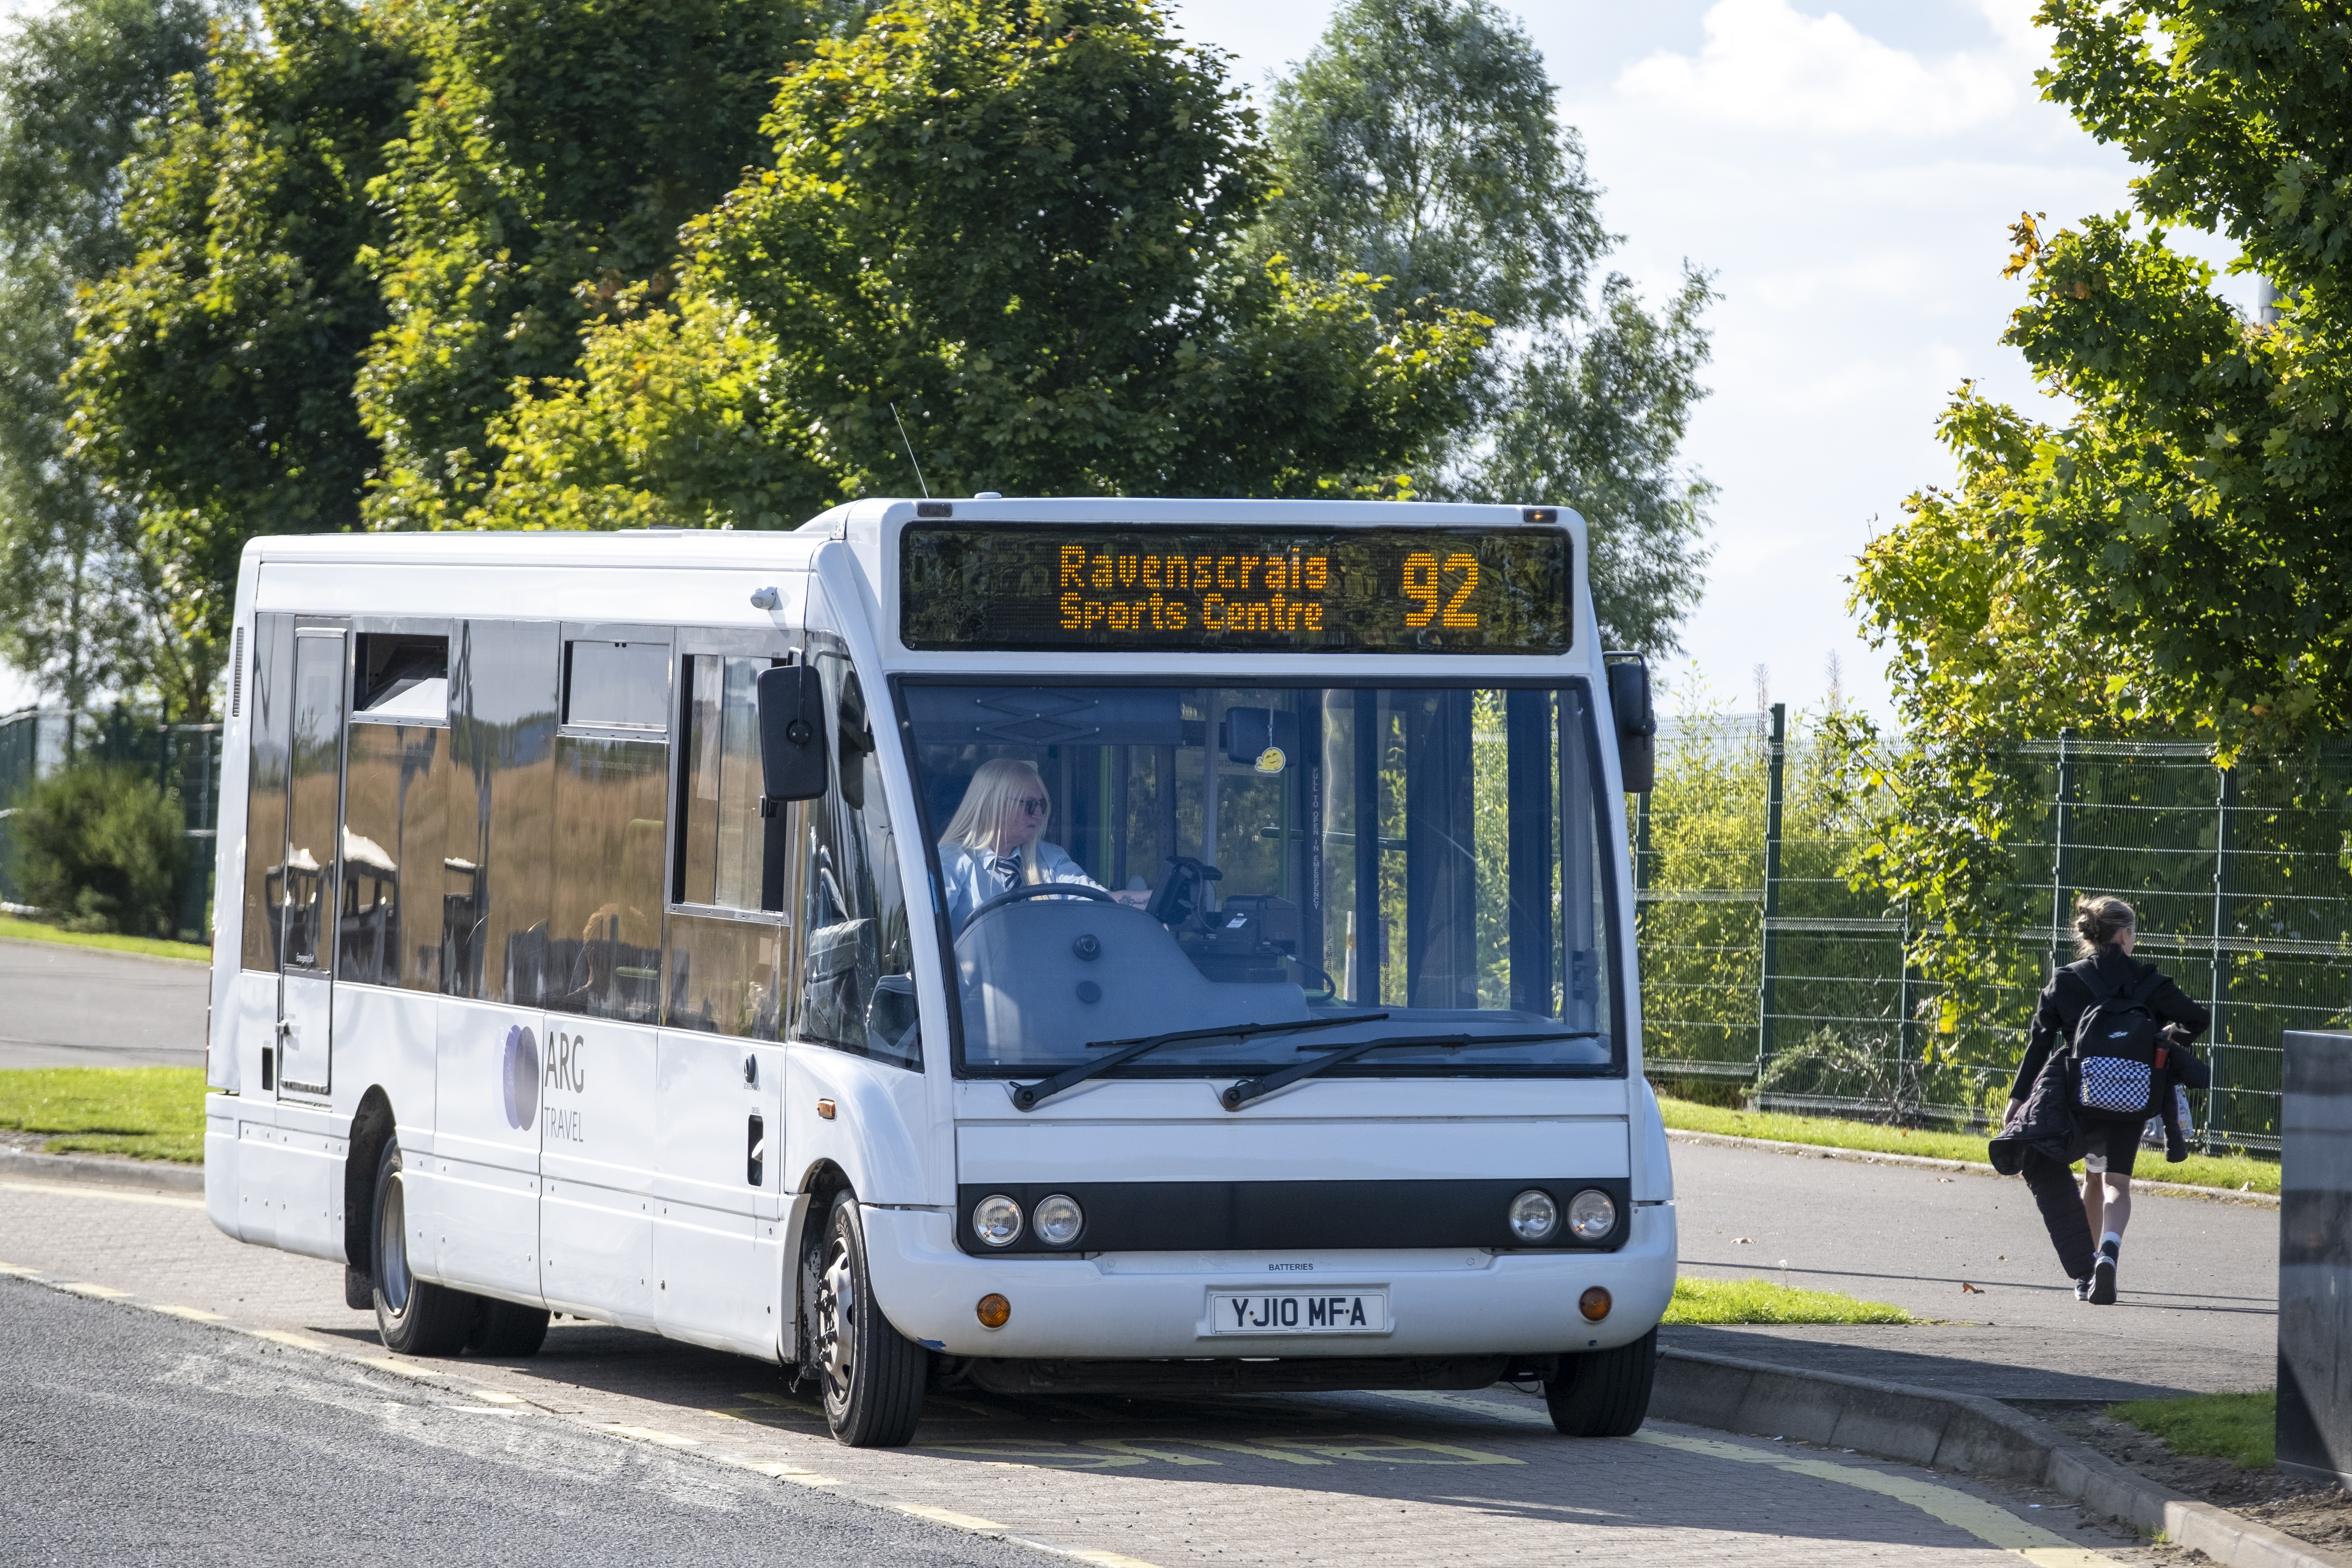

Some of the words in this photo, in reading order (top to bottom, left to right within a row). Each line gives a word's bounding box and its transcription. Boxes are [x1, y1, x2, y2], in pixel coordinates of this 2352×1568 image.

[1061, 545, 1328, 589] Ravenscraig
[1403, 553, 1479, 627] 92
[1060, 592, 1187, 629] Sports
[1203, 593, 1323, 630] Centre
[1313, 795, 1318, 807] TO
[1314, 839, 1319, 851] IN
[544, 1031, 585, 1093] ARG
[544, 1106, 584, 1142] TRAVEL
[1268, 1263, 1314, 1271] BATTERIES
[1231, 1297, 1298, 1327] YJ10
[1309, 1297, 1367, 1326] MFA
